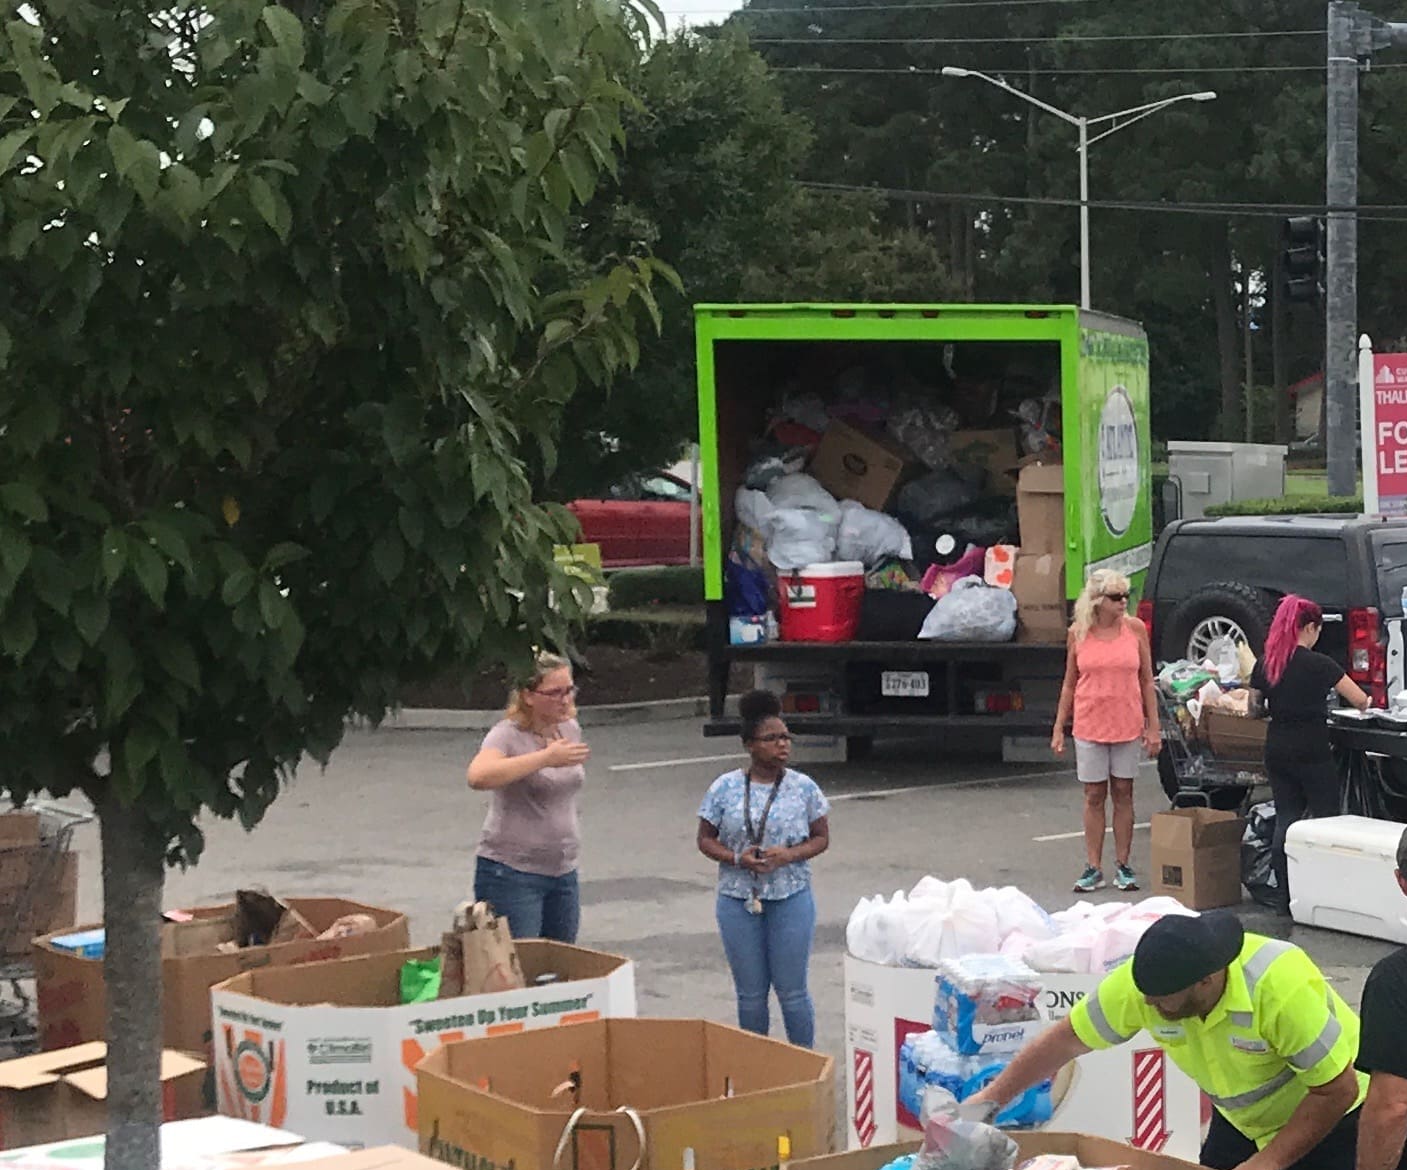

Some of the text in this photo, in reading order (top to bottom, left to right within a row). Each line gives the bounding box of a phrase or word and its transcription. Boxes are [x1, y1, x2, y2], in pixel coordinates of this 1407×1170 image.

[477, 1009, 496, 1025] Up
[498, 1004, 529, 1021] Your
[306, 1080, 380, 1095] Product of
[325, 1100, 364, 1115] U.S.A.
